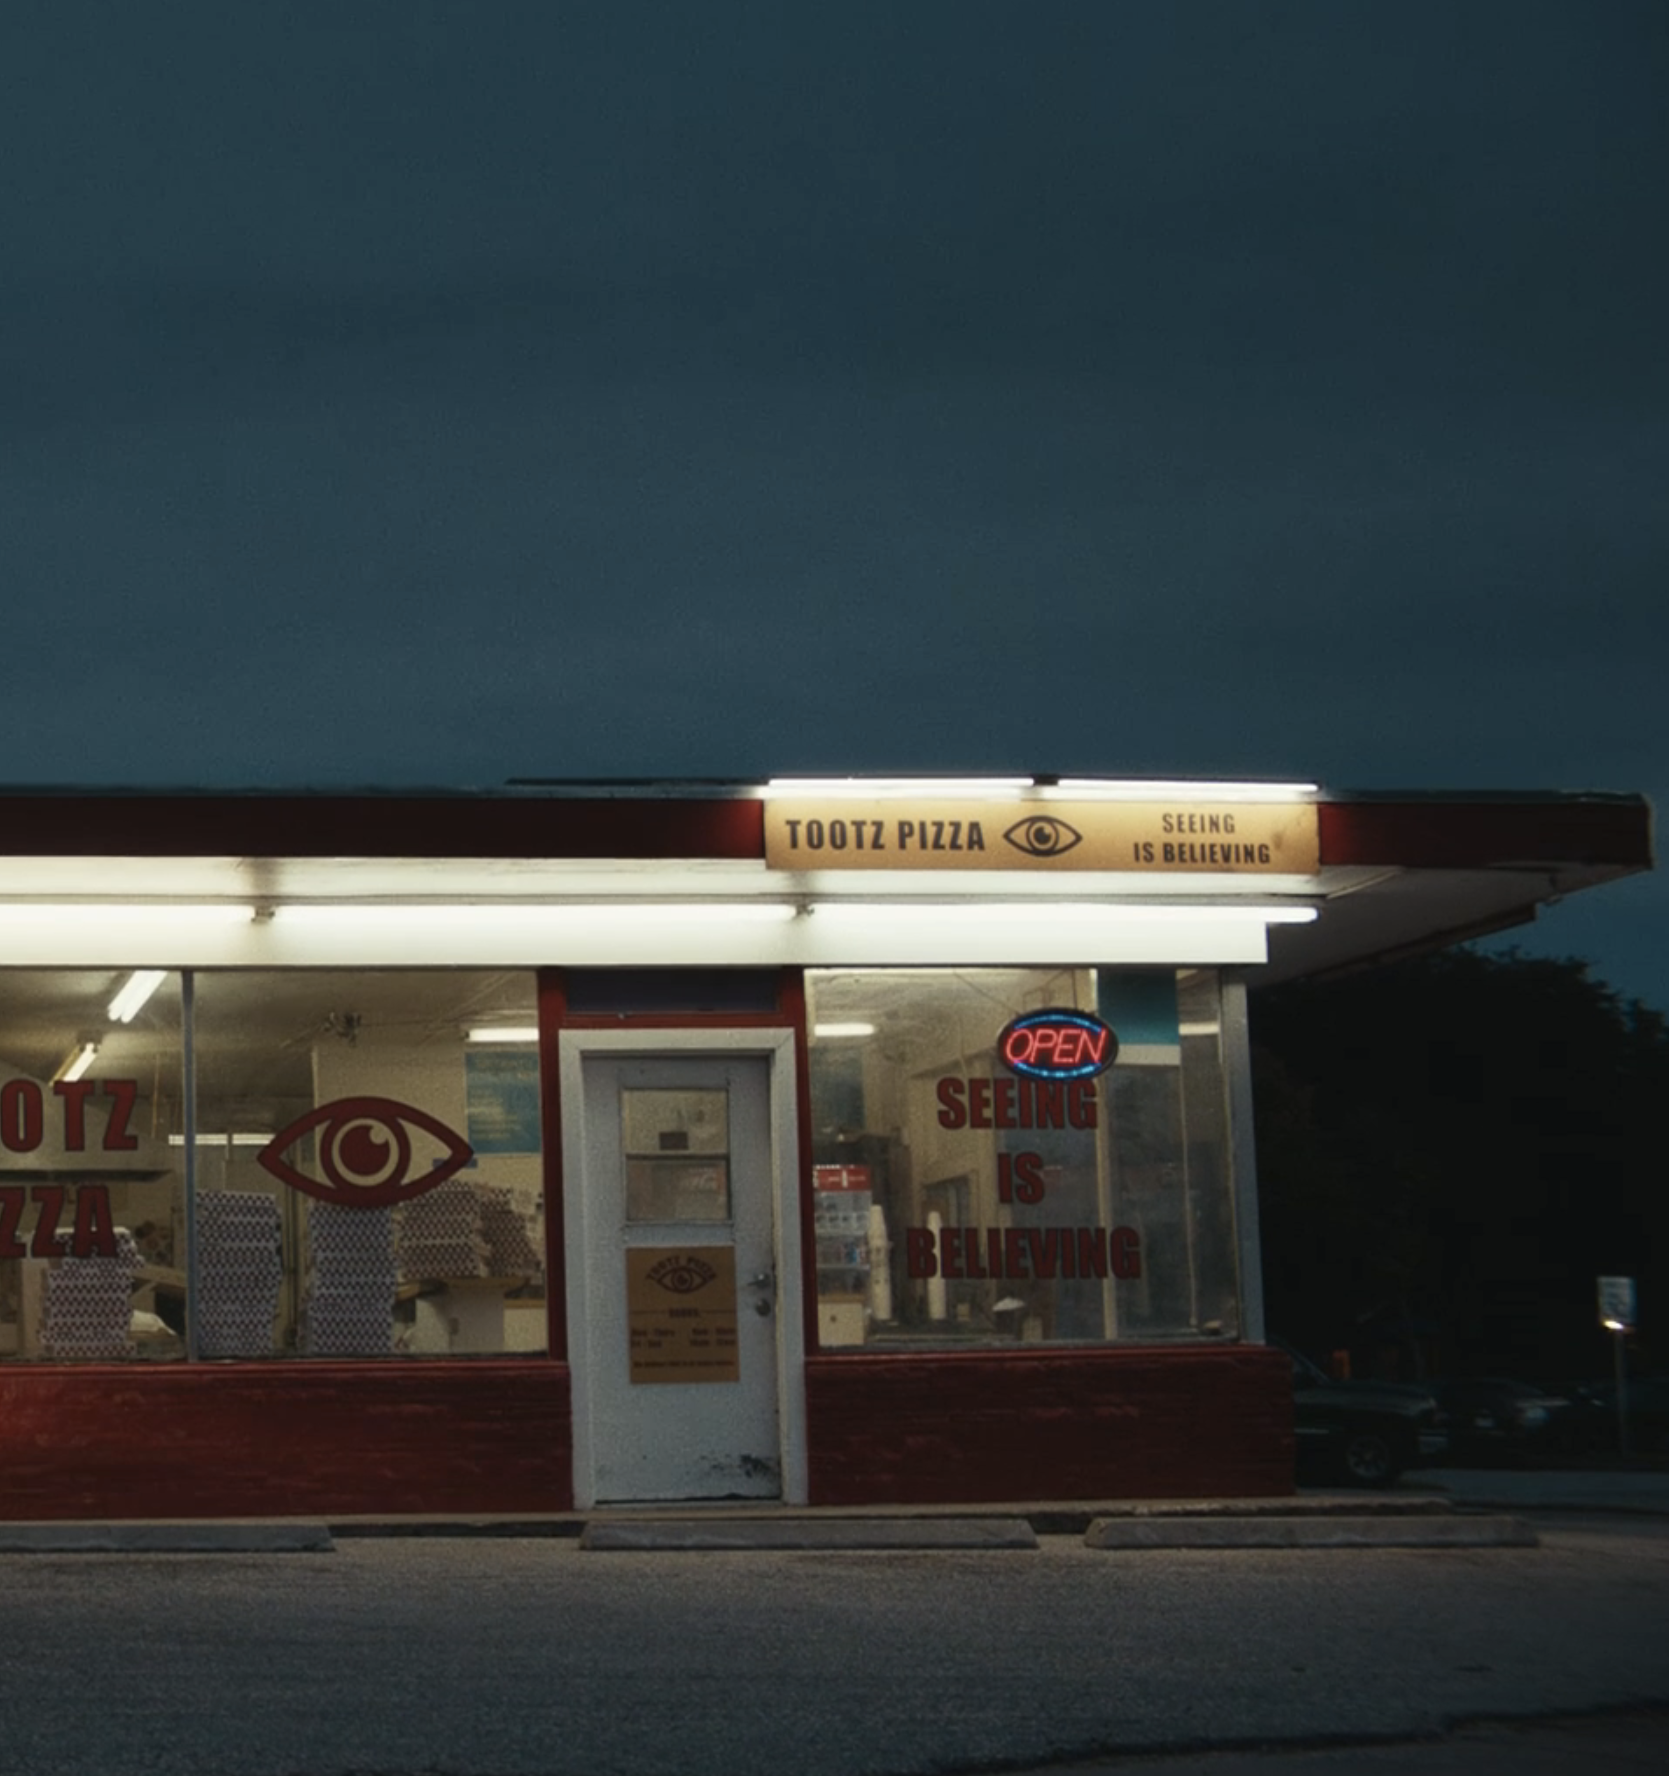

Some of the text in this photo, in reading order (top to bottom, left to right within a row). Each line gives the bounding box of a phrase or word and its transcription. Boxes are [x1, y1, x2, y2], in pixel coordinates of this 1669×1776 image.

[785, 819, 986, 851] TOOTZ PIZZA
[1161, 813, 1236, 834] SEEING
[1133, 842, 1271, 865] IS BELIEVING
[1005, 1028, 1107, 1064] OPEN
[936, 1077, 1098, 1130] SEEING
[997, 1152, 1045, 1205] IS
[906, 1226, 1142, 1280] BELIEVING
